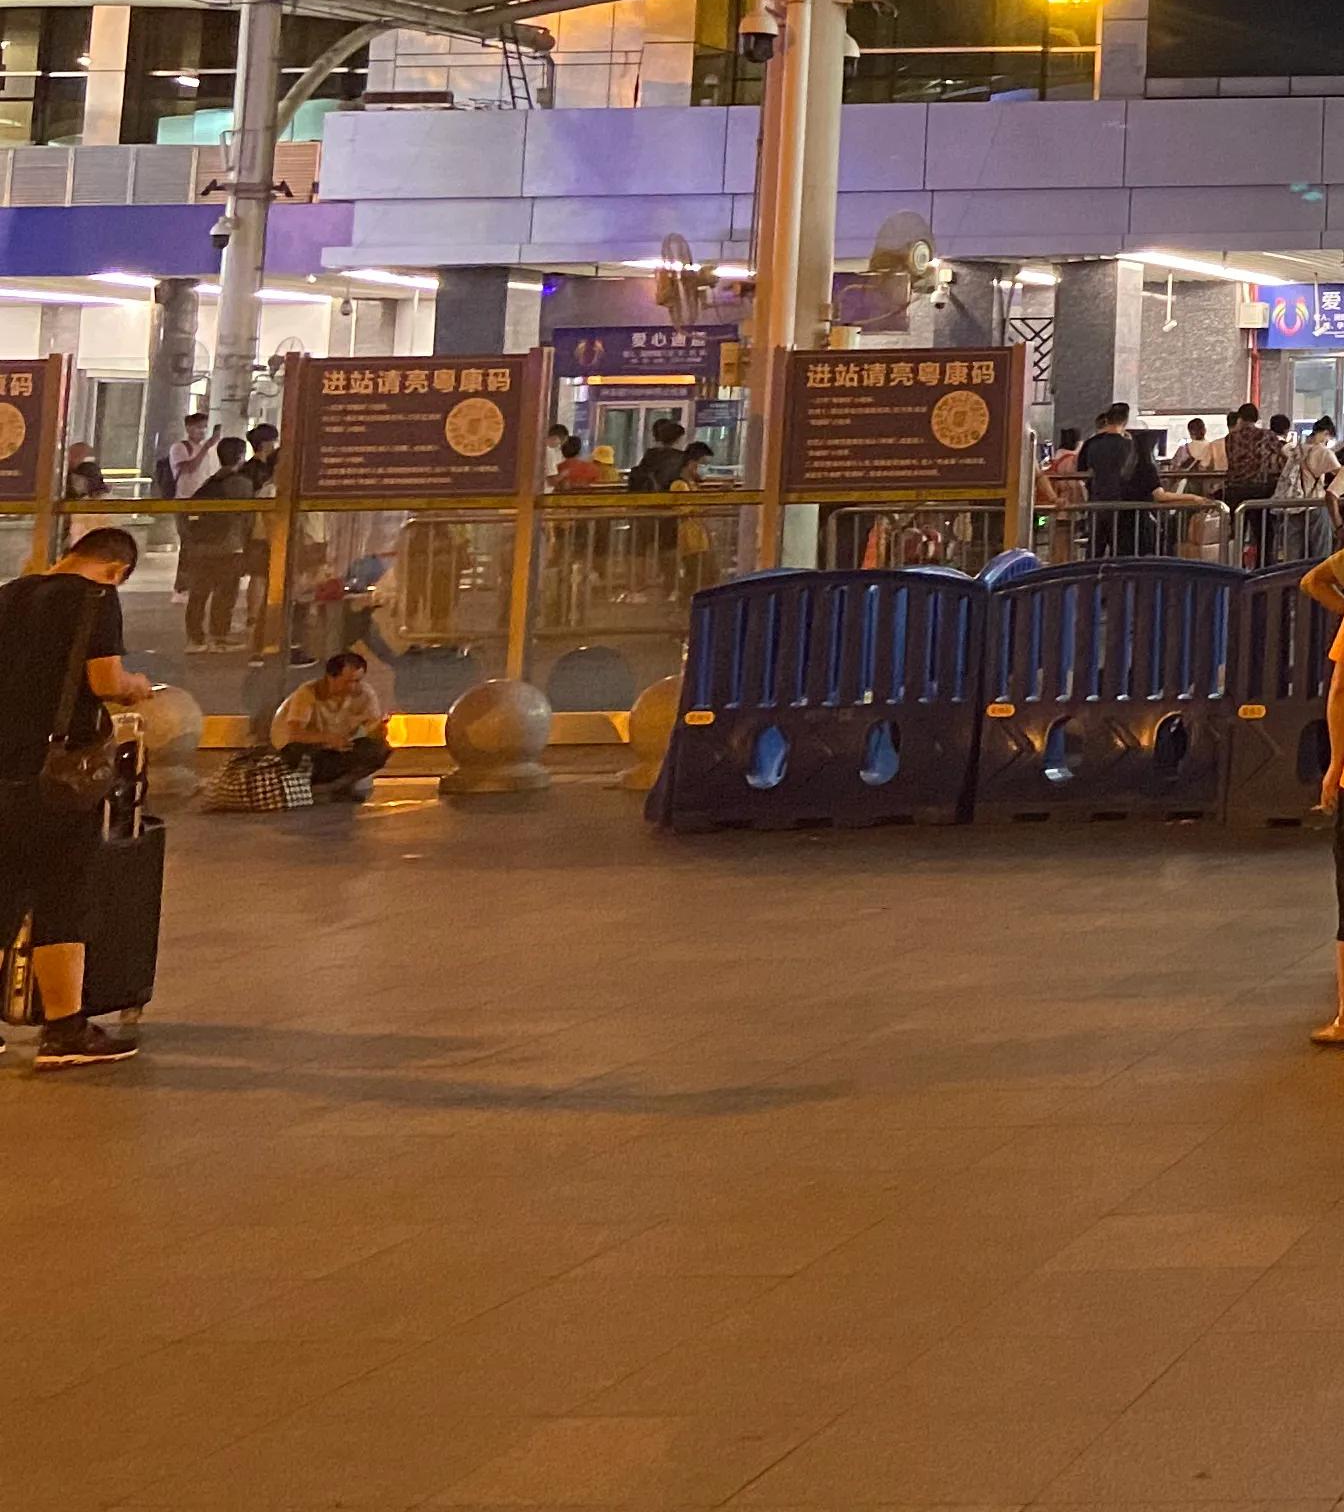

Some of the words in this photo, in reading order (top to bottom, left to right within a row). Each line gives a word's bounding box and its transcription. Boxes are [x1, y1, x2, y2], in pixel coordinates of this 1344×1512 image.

[321, 368, 512, 395] 进站请亮粤康码
[806, 361, 996, 388] 进站请亮粤康码
